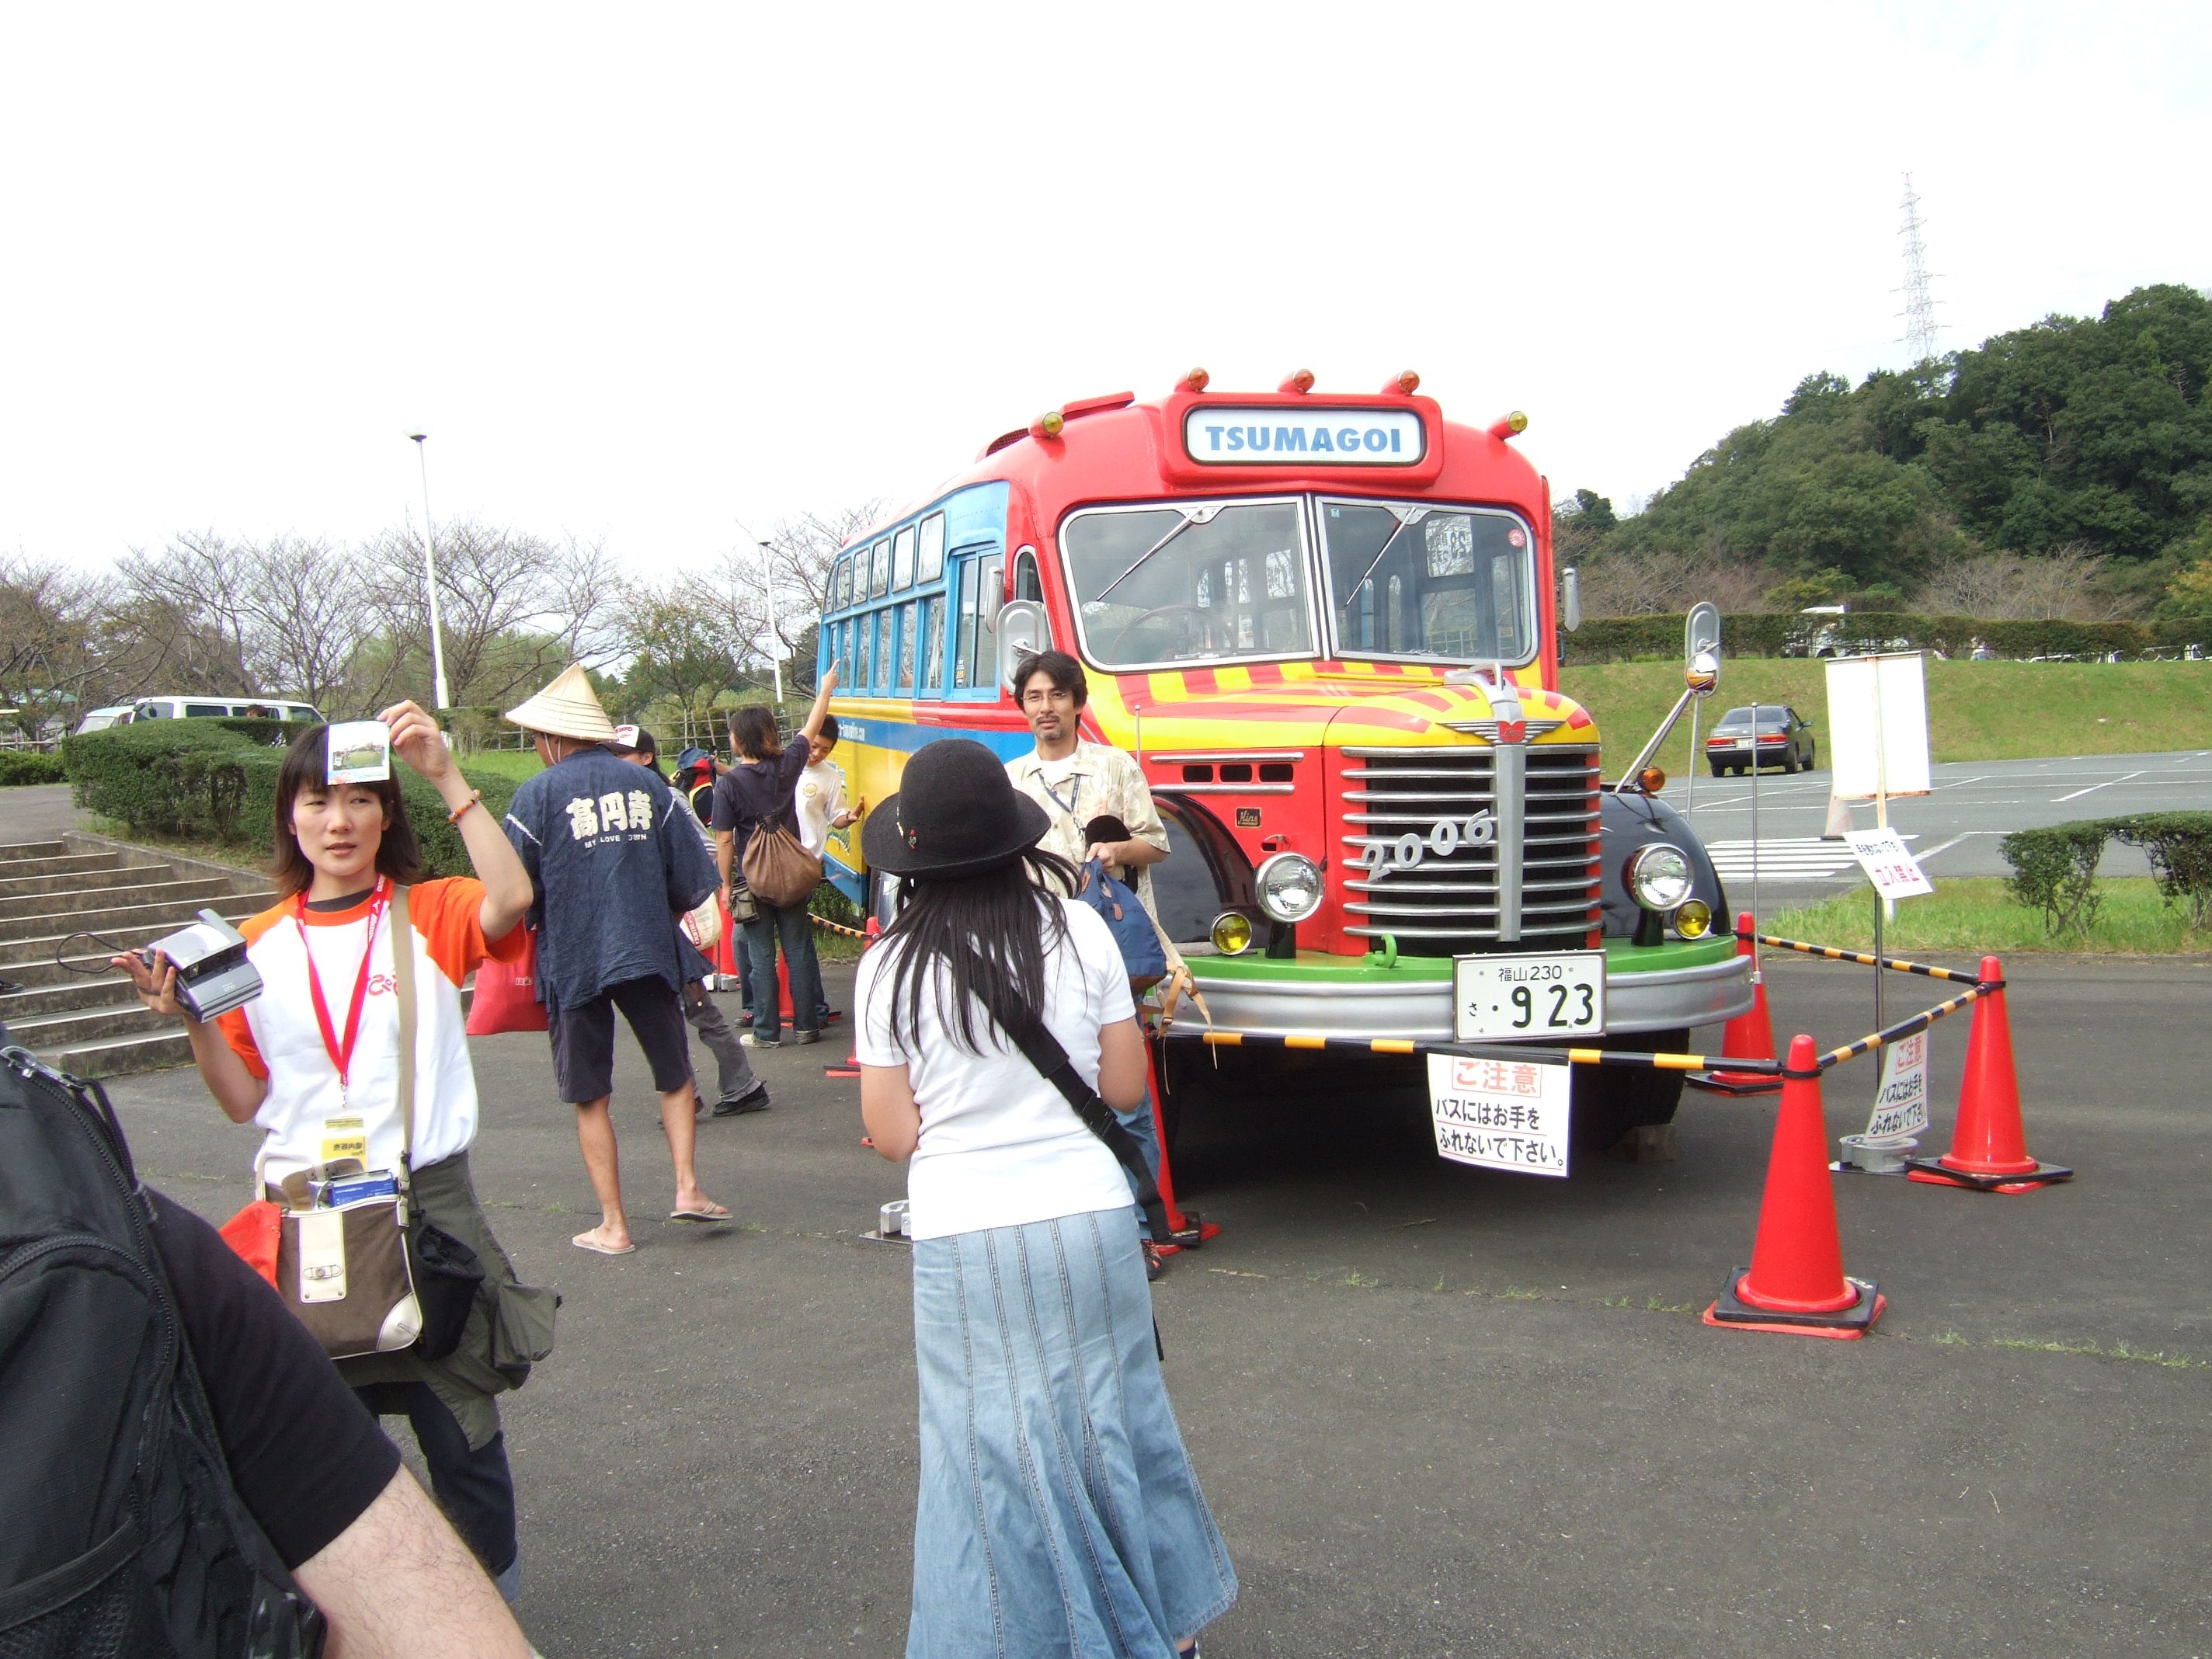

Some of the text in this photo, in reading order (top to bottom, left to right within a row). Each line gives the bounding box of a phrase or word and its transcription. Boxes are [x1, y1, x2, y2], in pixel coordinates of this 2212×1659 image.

[1205, 426, 1400, 453] TSUMAGOI
[585, 839, 596, 849] MY
[600, 834, 621, 843] LOVE
[1361, 809, 1493, 883] 2006
[1469, 1002, 1477, 1017] さ
[1456, 1060, 1538, 1094] ご注意
[1436, 1098, 1540, 1131] バスにはお手を
